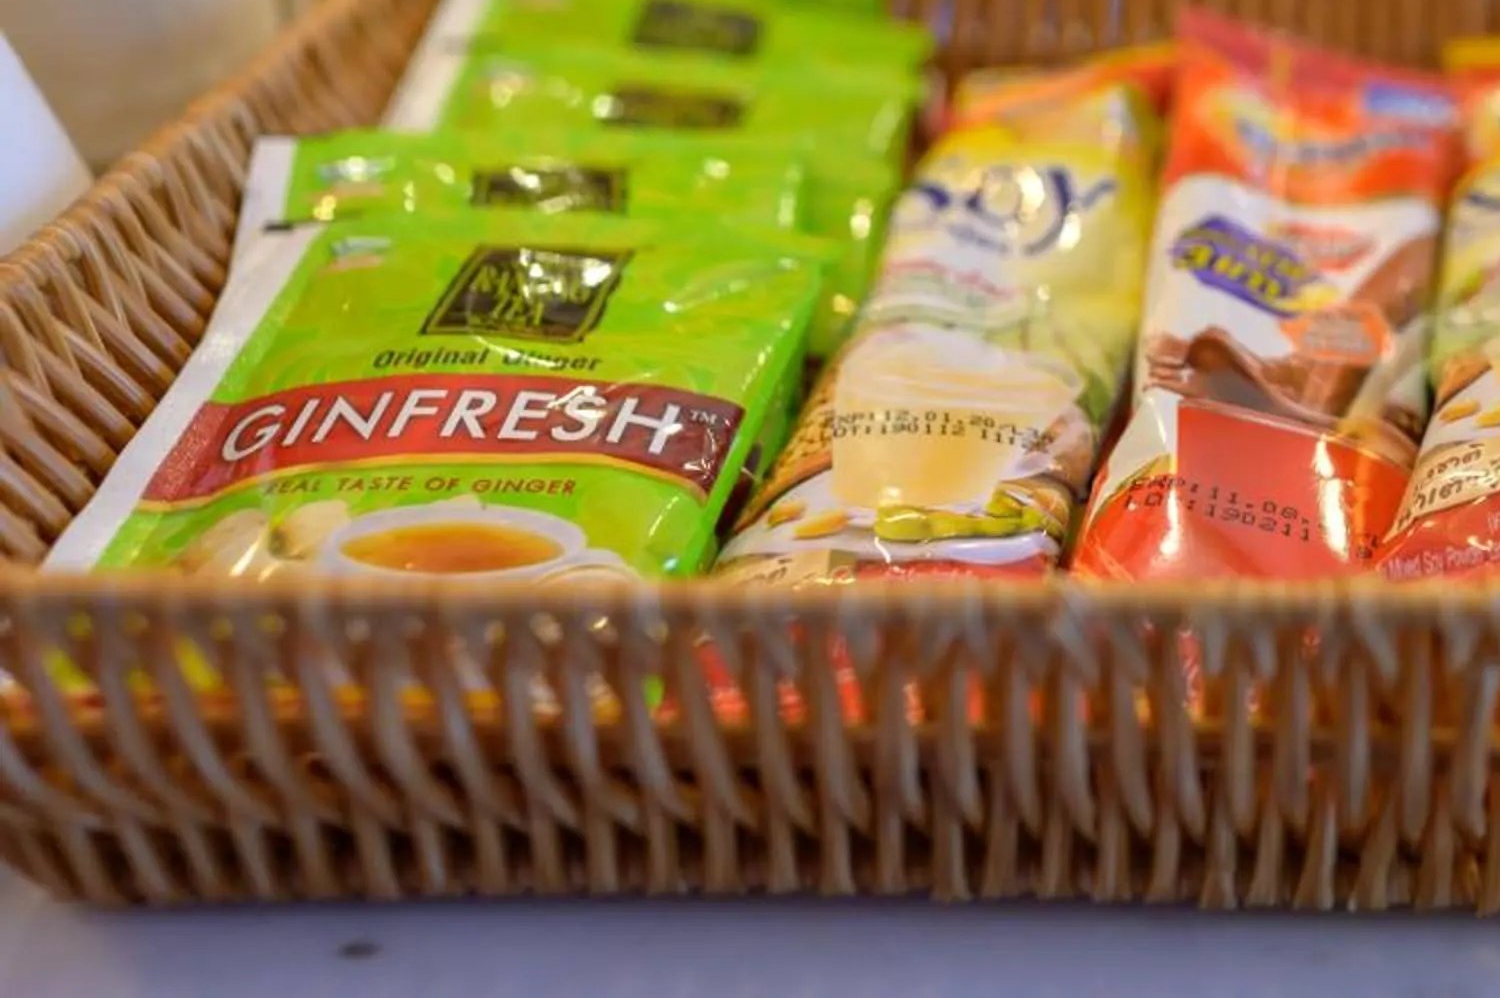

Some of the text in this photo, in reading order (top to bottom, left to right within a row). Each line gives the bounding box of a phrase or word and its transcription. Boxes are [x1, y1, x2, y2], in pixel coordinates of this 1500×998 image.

[373, 347, 490, 369] Original
[221, 387, 683, 462] GINFRESH
[336, 476, 414, 493] TASTE
[427, 476, 457, 492] OF
[471, 477, 577, 496] GINGER
